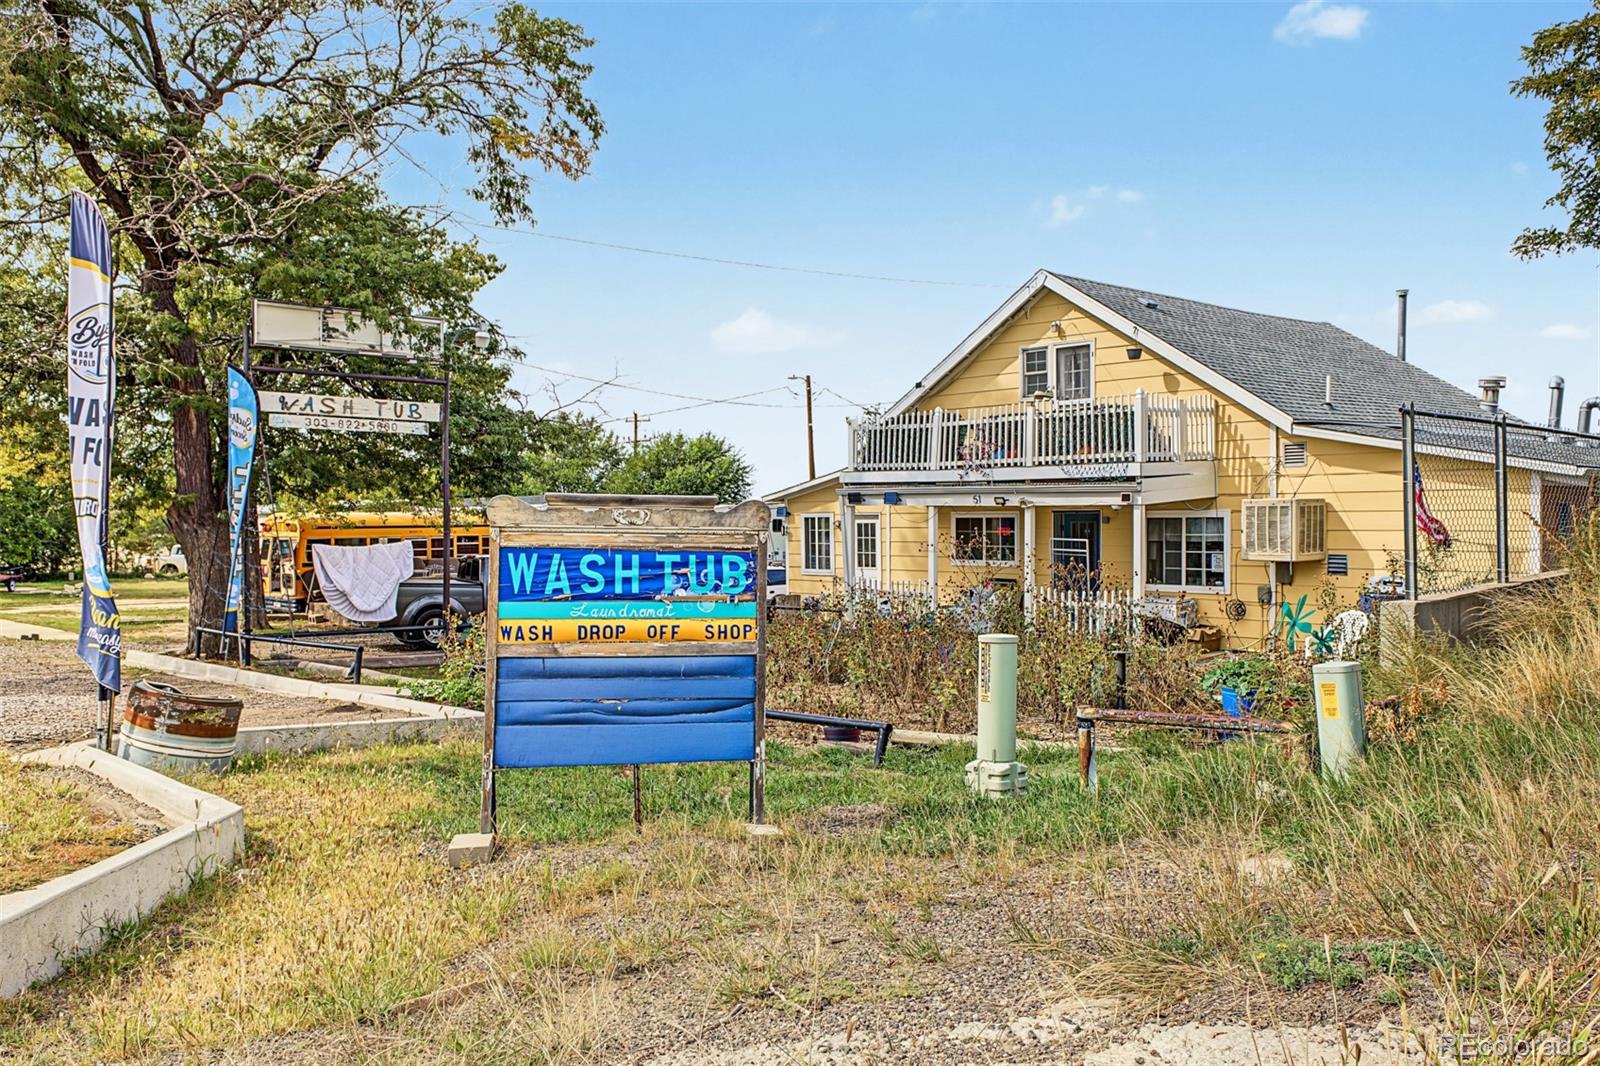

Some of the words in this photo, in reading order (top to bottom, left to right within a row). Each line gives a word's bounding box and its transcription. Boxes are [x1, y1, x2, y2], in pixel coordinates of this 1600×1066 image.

[375, 401, 422, 420] TUB
[972, 494, 982, 505] 51
[507, 552, 640, 595] WASH
[656, 554, 747, 595] TUB
[500, 626, 553, 642] WASH
[577, 625, 627, 640] DROP
[647, 624, 681, 639] OFF
